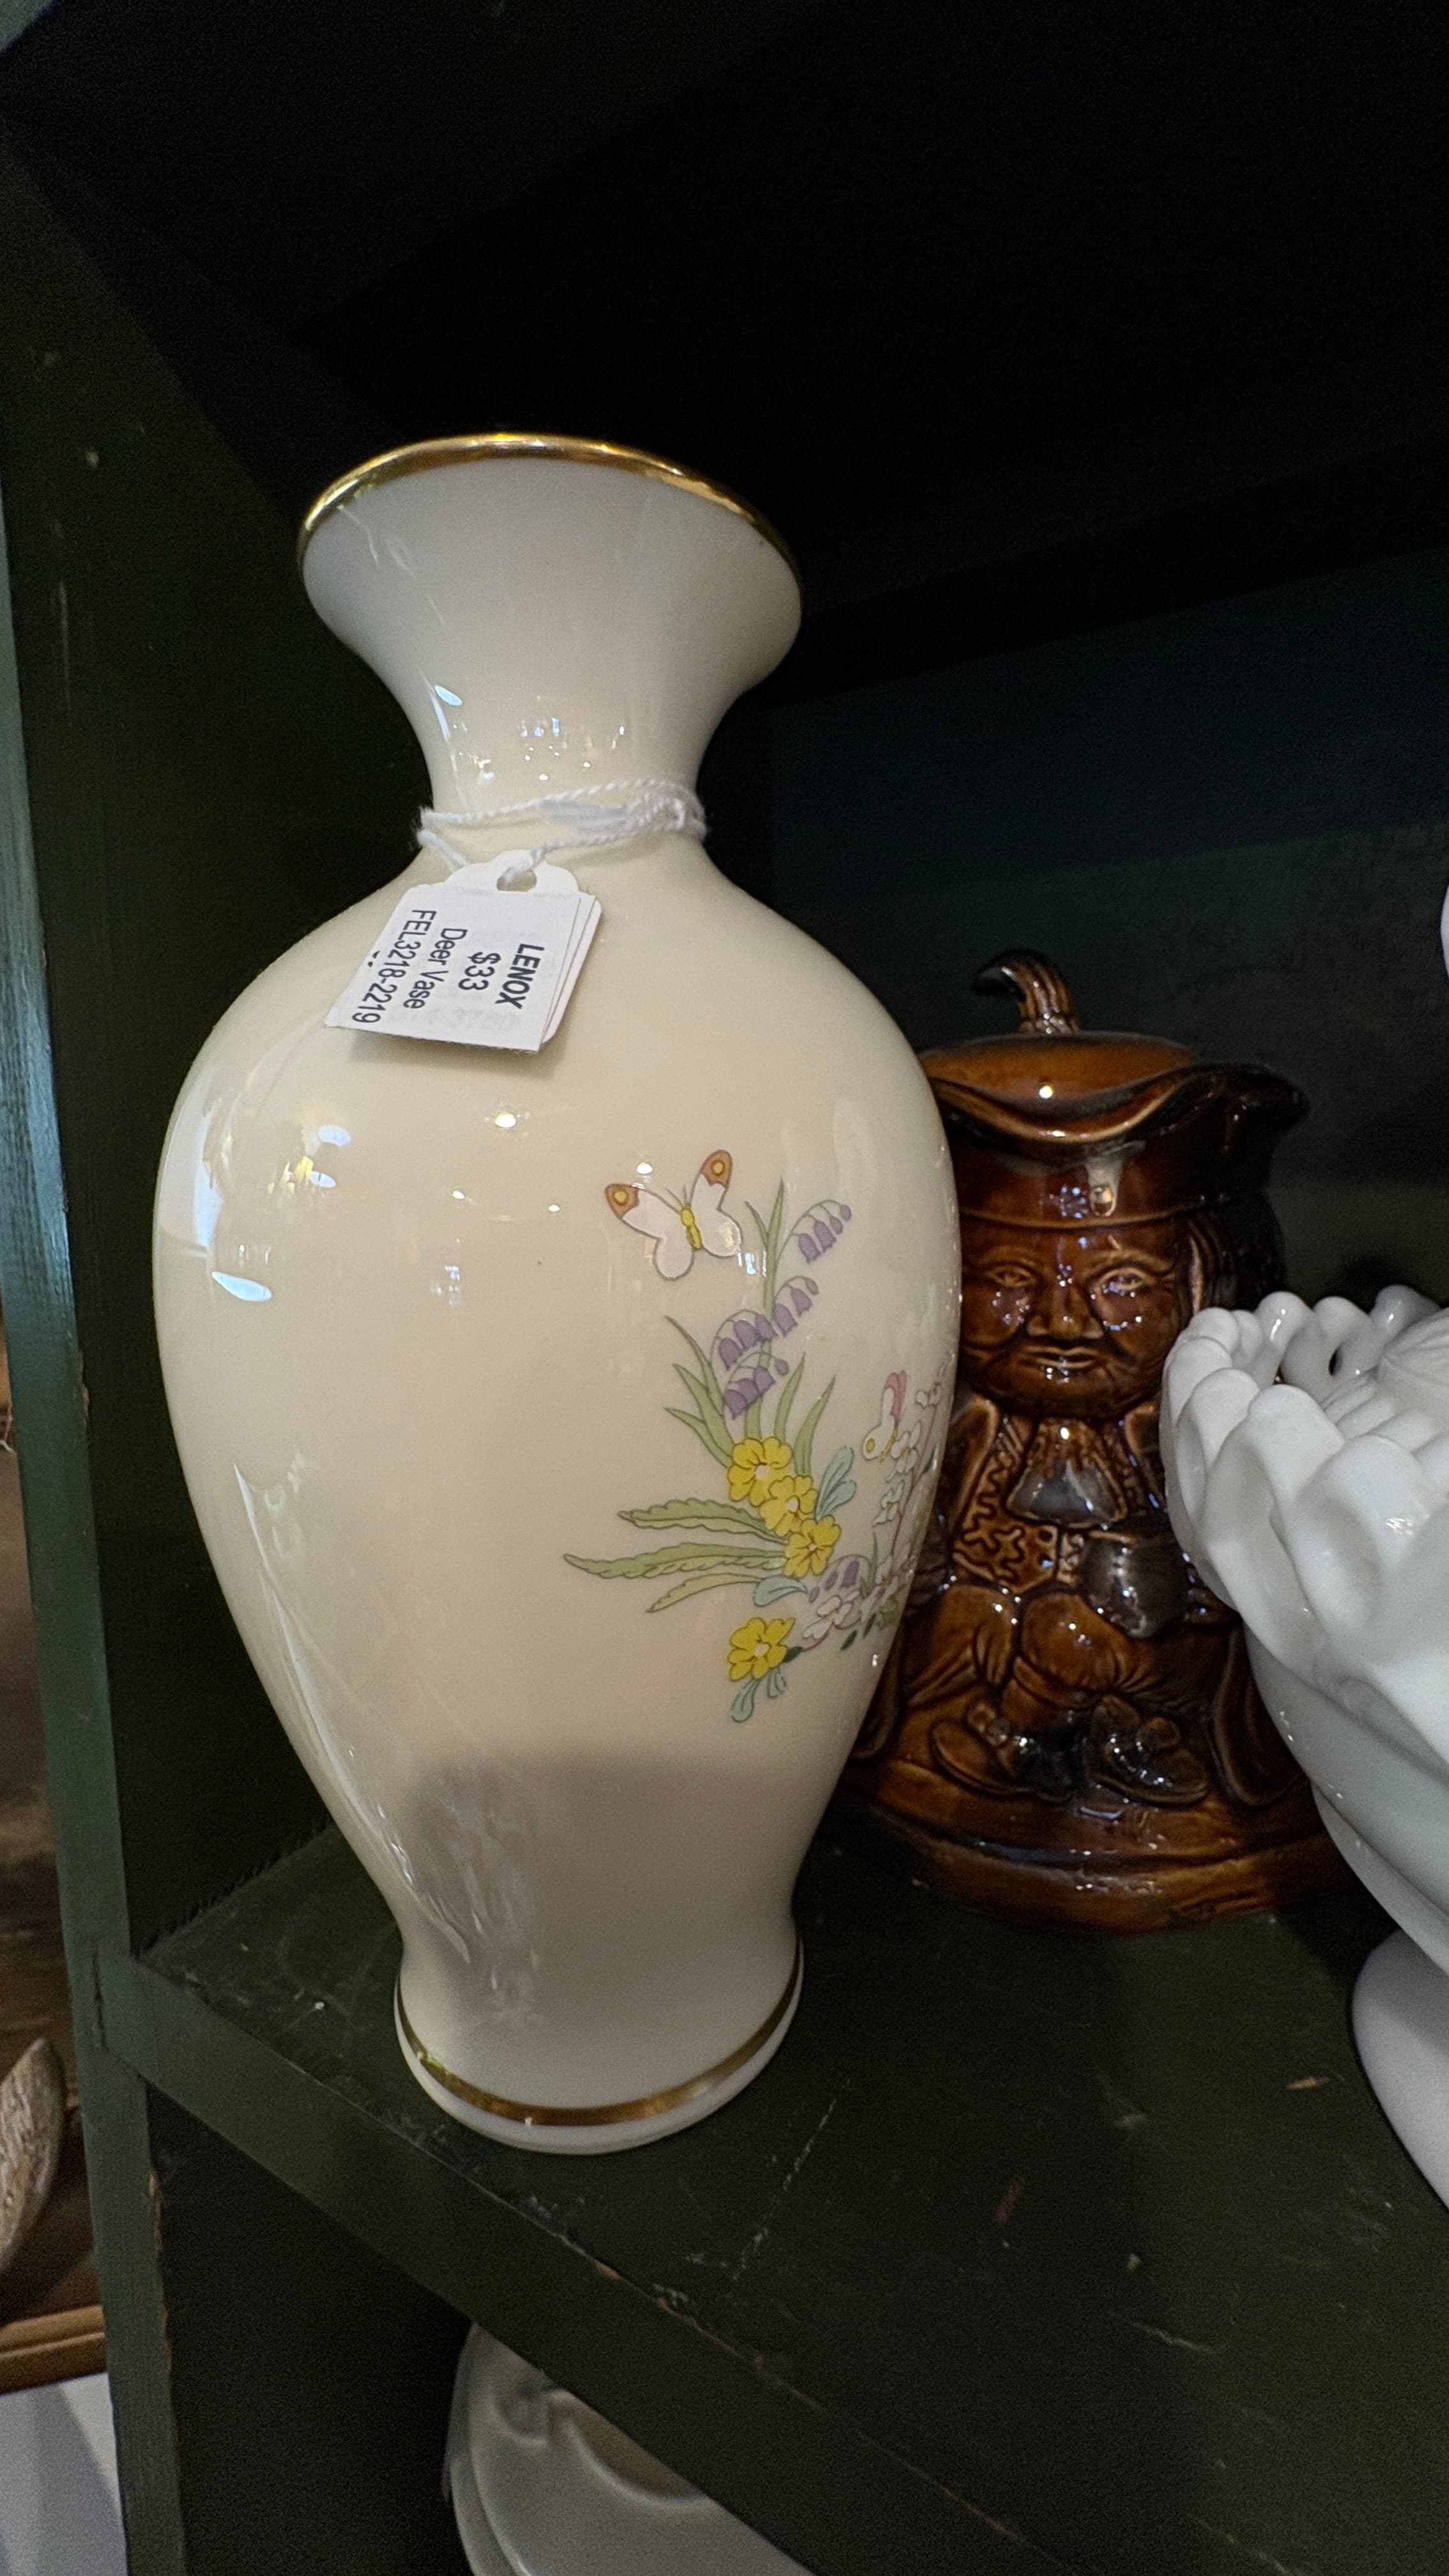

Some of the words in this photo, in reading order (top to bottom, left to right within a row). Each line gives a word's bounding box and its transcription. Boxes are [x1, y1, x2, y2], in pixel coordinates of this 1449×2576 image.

[352, 909, 436, 1023] FEL3218-2219
[430, 928, 468, 965] Deer
[403, 970, 449, 1009] Vase
[458, 951, 501, 991] $33
[495, 944, 544, 1009] LENOX
